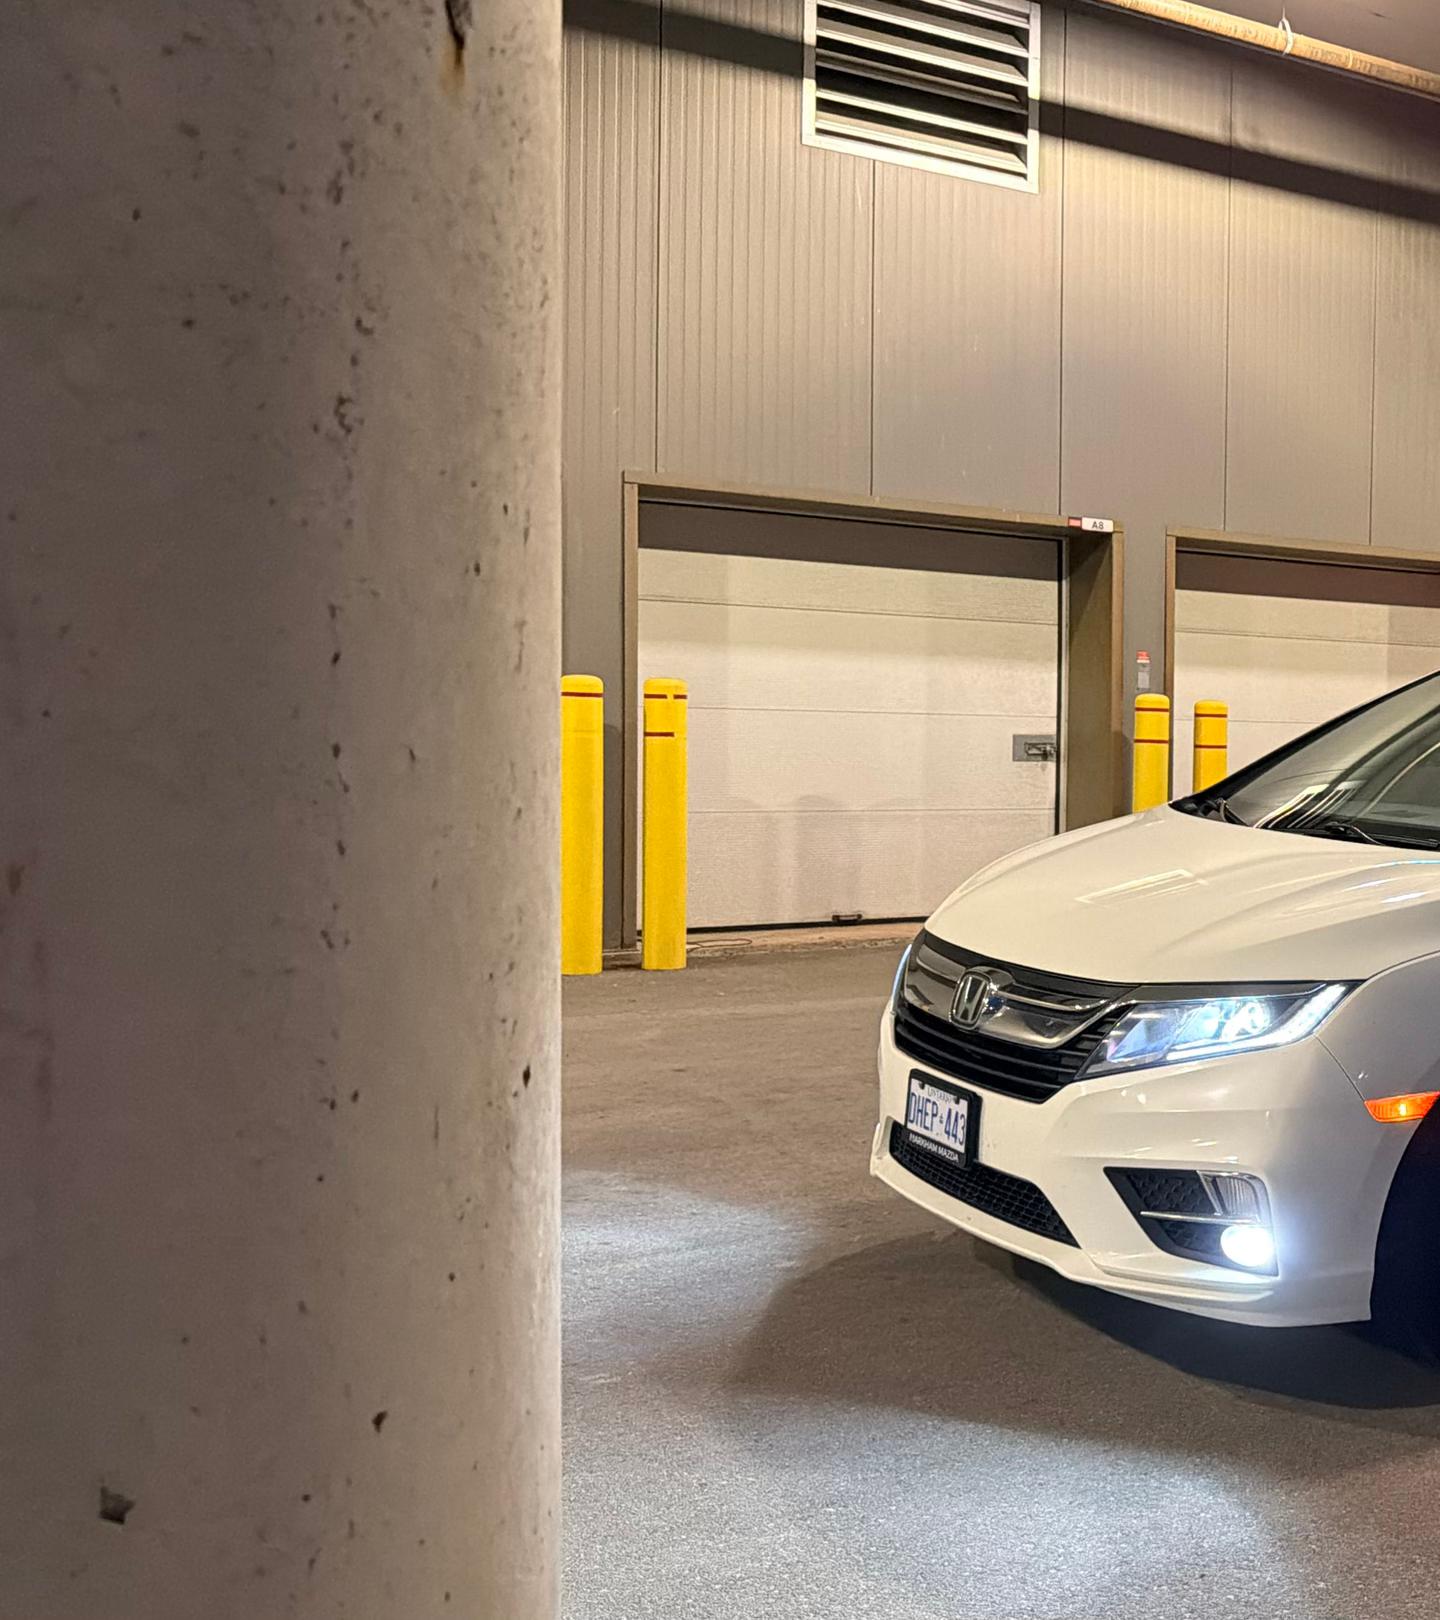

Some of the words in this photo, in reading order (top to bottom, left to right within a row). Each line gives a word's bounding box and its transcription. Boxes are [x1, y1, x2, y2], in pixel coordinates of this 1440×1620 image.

[1091, 521, 1104, 530] A8
[909, 1133, 938, 1153] MARKHAM
[938, 1146, 959, 1163] MAZDA
